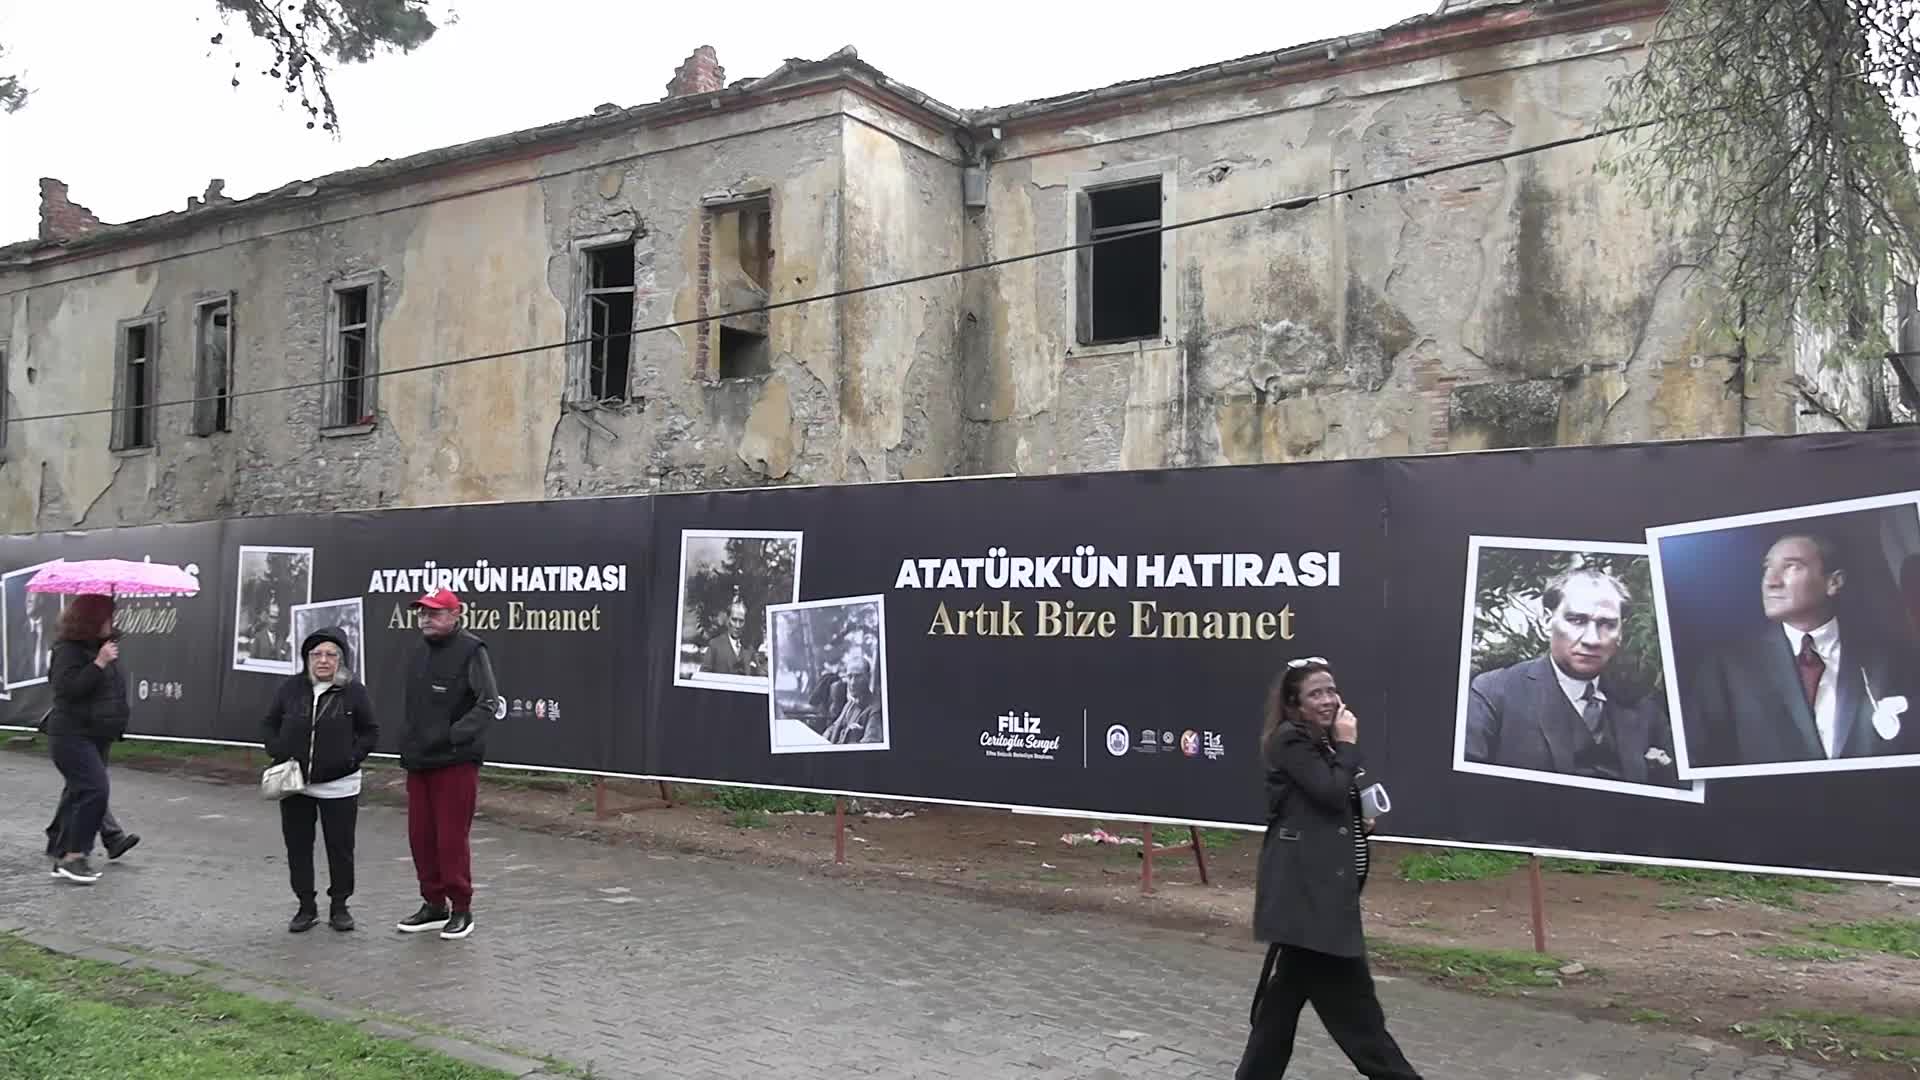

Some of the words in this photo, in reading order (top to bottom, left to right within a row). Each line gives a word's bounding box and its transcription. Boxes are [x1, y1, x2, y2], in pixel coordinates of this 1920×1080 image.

[369, 561, 507, 593] ATATÜRK'ÜN
[511, 565, 627, 592] HATIRASI
[895, 546, 1128, 588] ATATÜRK'ÜN
[1136, 551, 1341, 588] HATIRASI
[507, 602, 601, 631] Emanet
[928, 600, 1025, 637] Artık
[1035, 601, 1117, 639] Bize
[1128, 600, 1296, 641] Emanet
[998, 711, 1041, 734] FİLİZ
